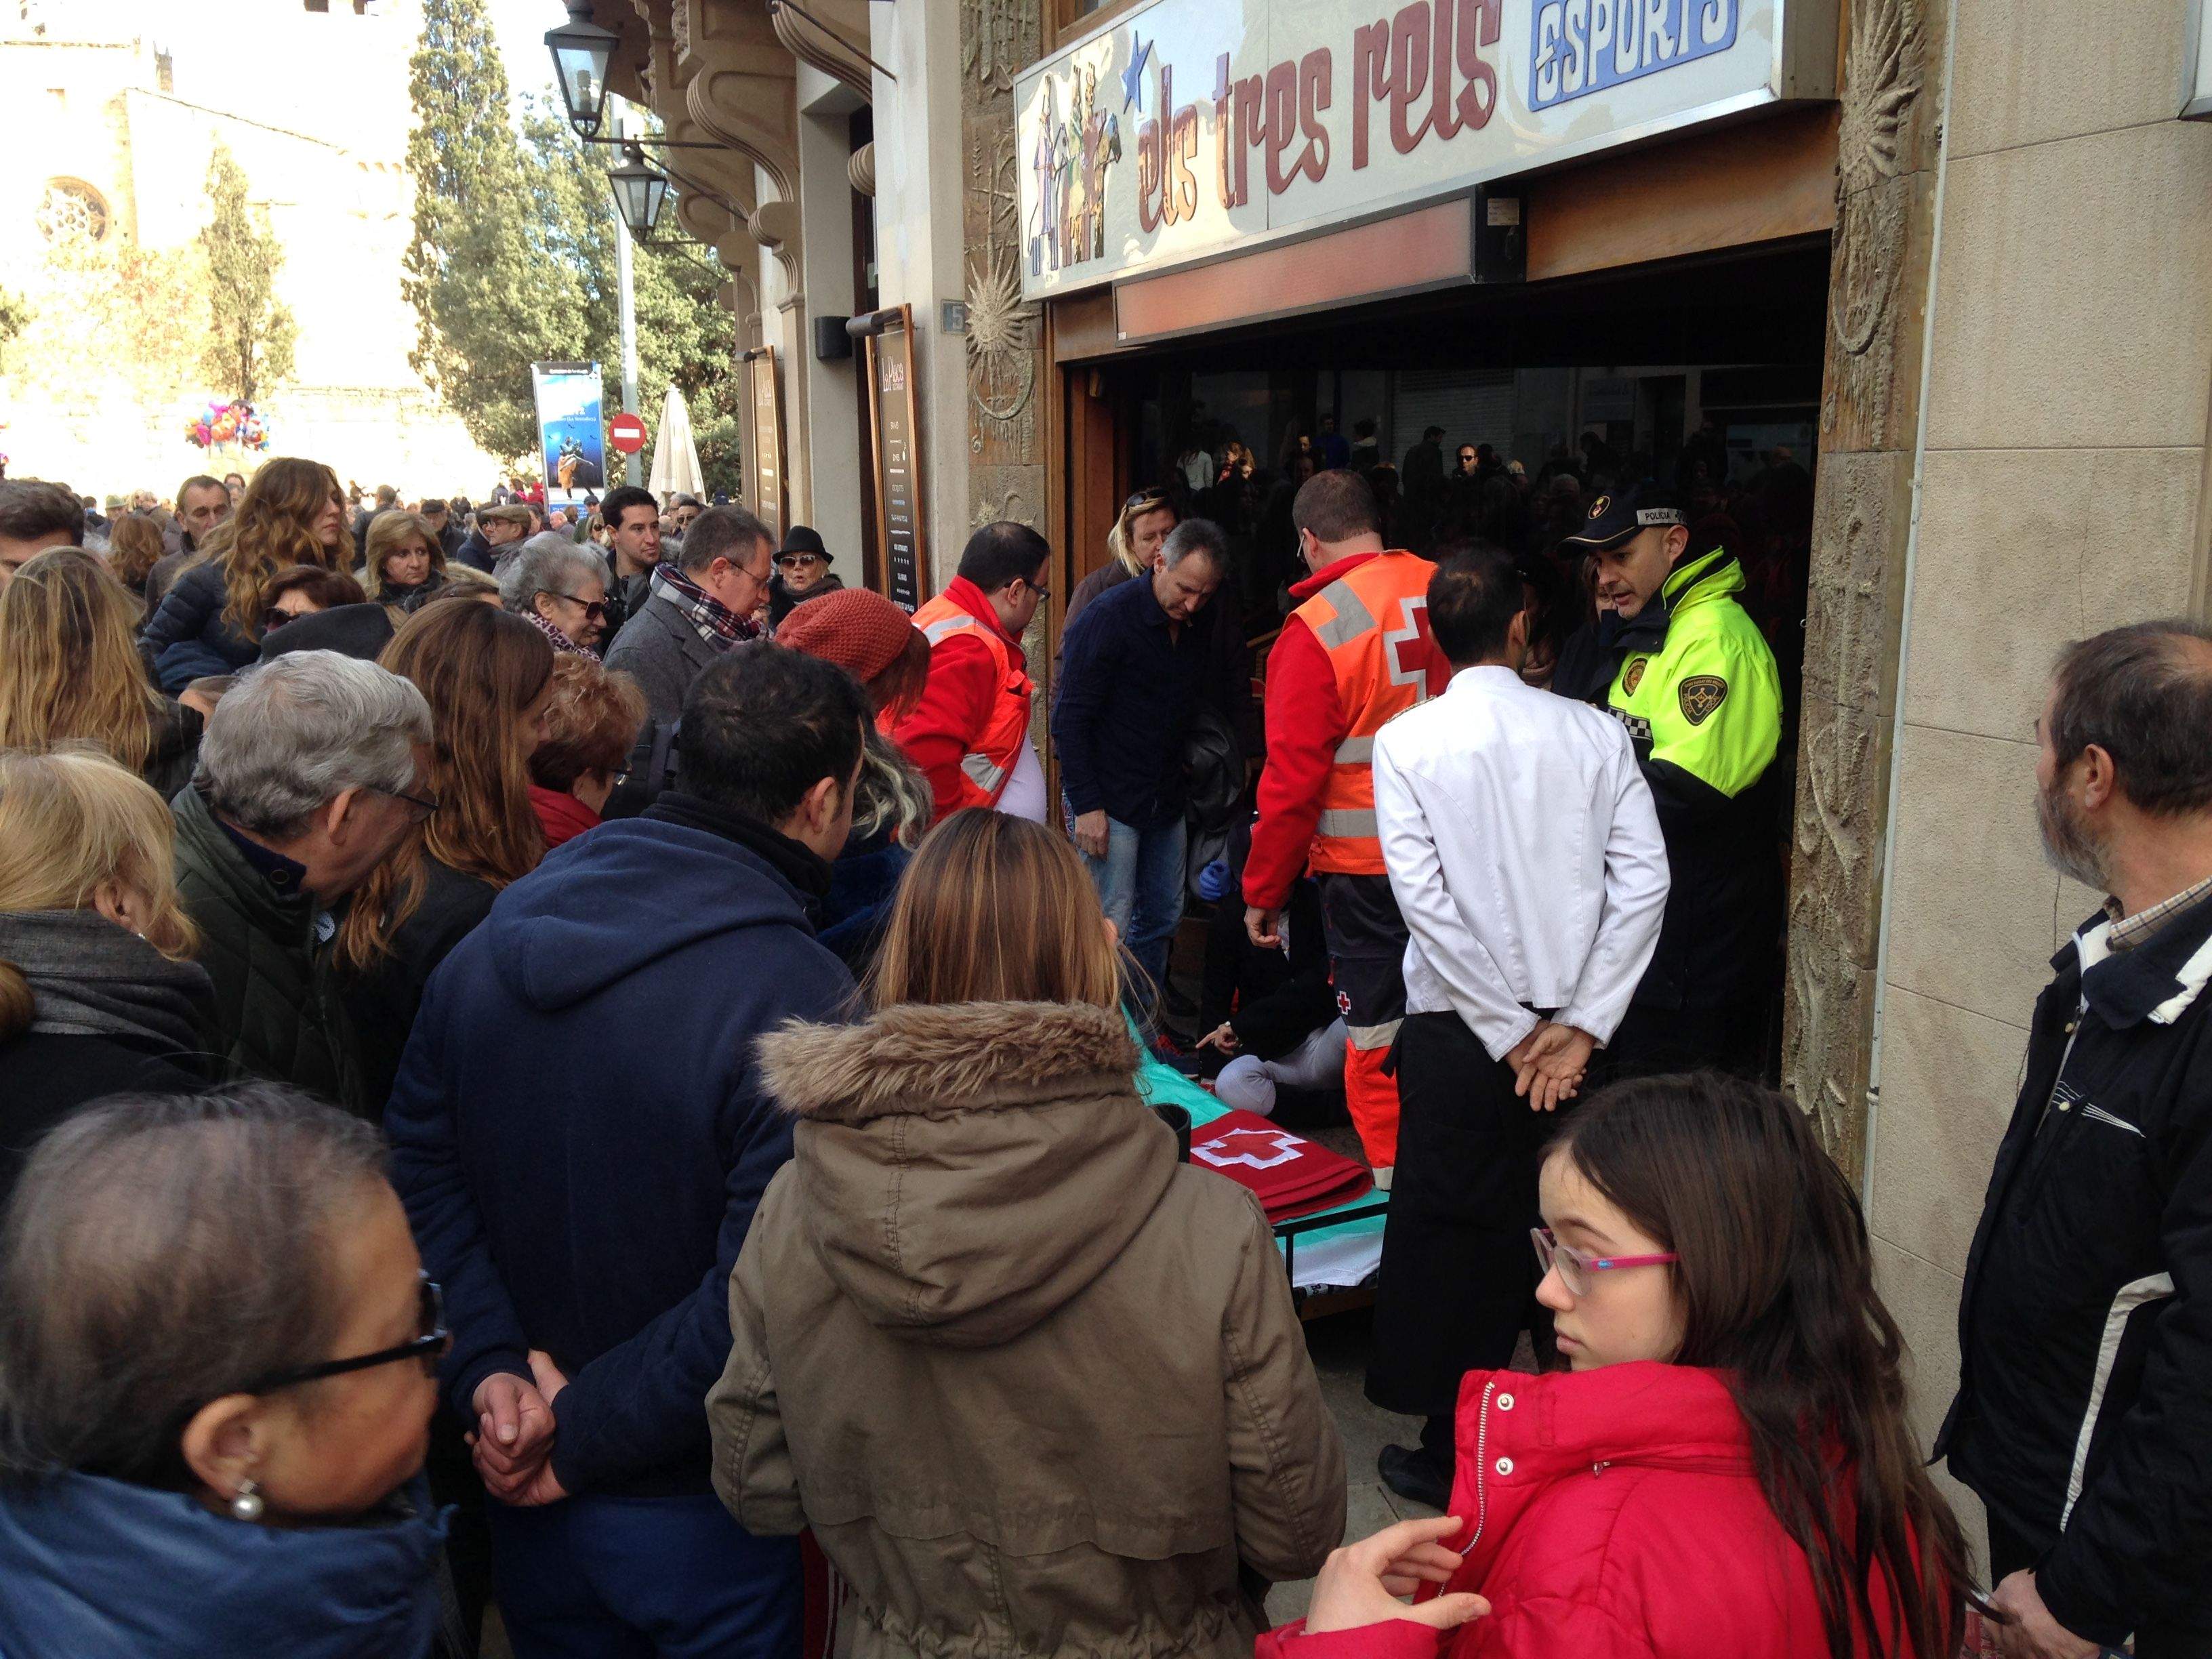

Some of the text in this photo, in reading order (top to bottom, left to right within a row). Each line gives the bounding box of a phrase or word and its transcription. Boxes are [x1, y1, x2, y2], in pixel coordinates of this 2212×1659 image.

[1138, 64, 1198, 232] els
[1212, 52, 1332, 209] tres
[953, 305, 963, 329] 5
